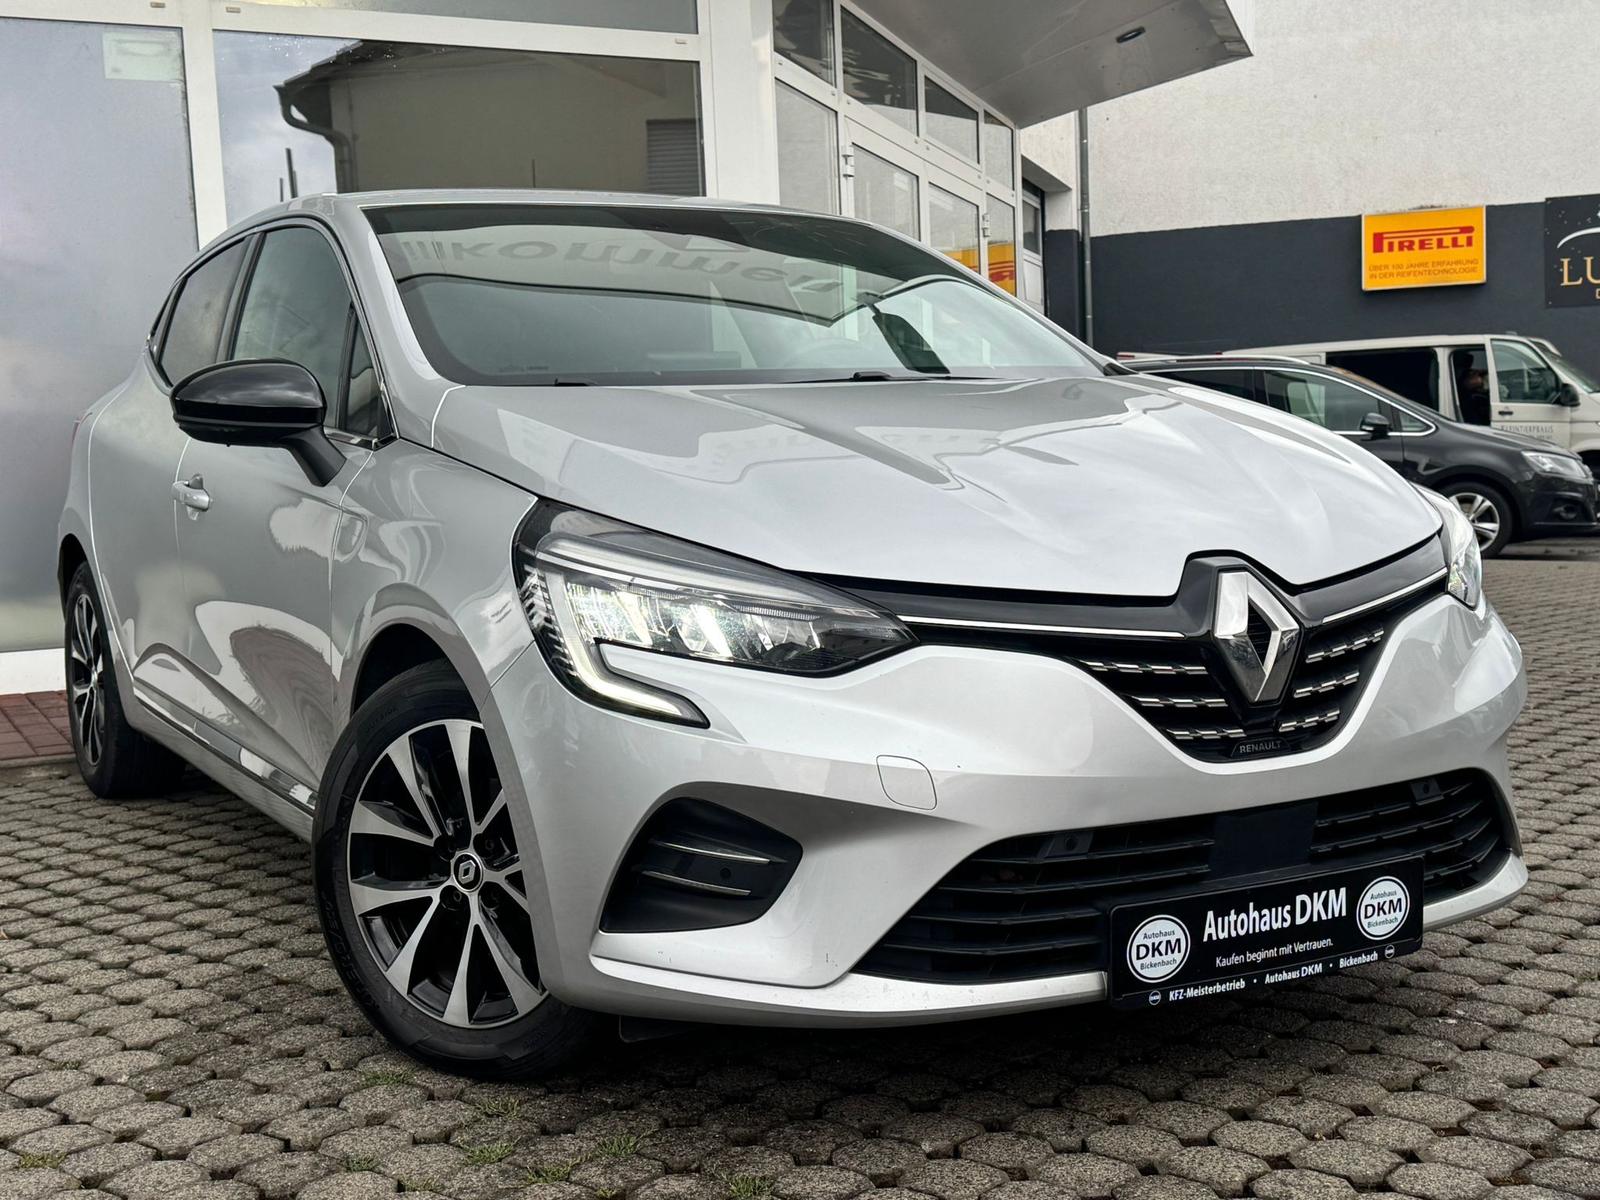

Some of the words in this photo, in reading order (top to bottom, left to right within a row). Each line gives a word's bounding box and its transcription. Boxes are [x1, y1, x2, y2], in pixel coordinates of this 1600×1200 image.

[1373, 225, 1475, 254] PIRELLI
[1240, 740, 1281, 753] RENAULT
[1370, 890, 1397, 900] Autohaus
[1203, 901, 1291, 942] Autohaus
[1295, 887, 1347, 925] DKM
[1364, 897, 1402, 920] DKM
[1367, 916, 1399, 929] Bickenbach
[1143, 930, 1176, 940] Autohaus
[1136, 937, 1182, 961] DKM
[1215, 953, 1244, 968] Kaufen
[1246, 948, 1277, 963] beginnt
[1279, 944, 1293, 956] mit
[1293, 938, 1334, 953] Vertrauen.
[1140, 958, 1178, 971] Bickenbach
[1168, 979, 1246, 1002] KFZ-Meisterbetrieb
[1264, 970, 1300, 984] Autohaus
[1301, 963, 1323, 977] DKM
[1339, 950, 1378, 968] Bickenbach
